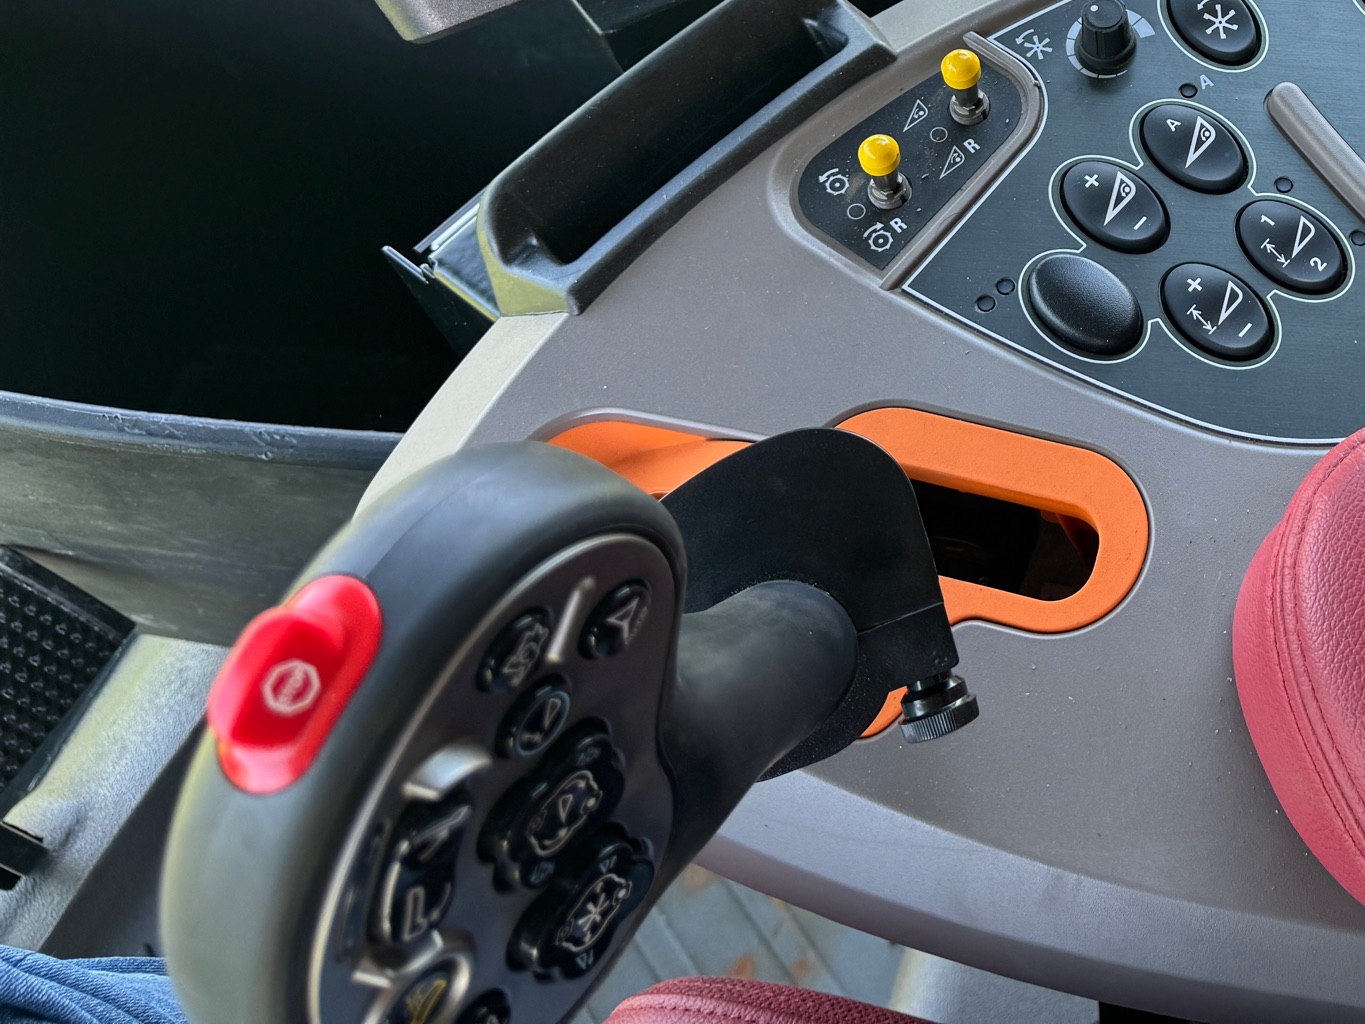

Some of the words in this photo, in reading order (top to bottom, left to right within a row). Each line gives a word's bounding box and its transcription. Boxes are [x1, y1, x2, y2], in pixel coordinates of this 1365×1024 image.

[1199, 74, 1215, 90] A
[1165, 118, 1182, 132] A
[962, 138, 981, 154] R
[889, 217, 908, 234] R
[1260, 214, 1276, 226] 1
[1309, 257, 1328, 272] 2
